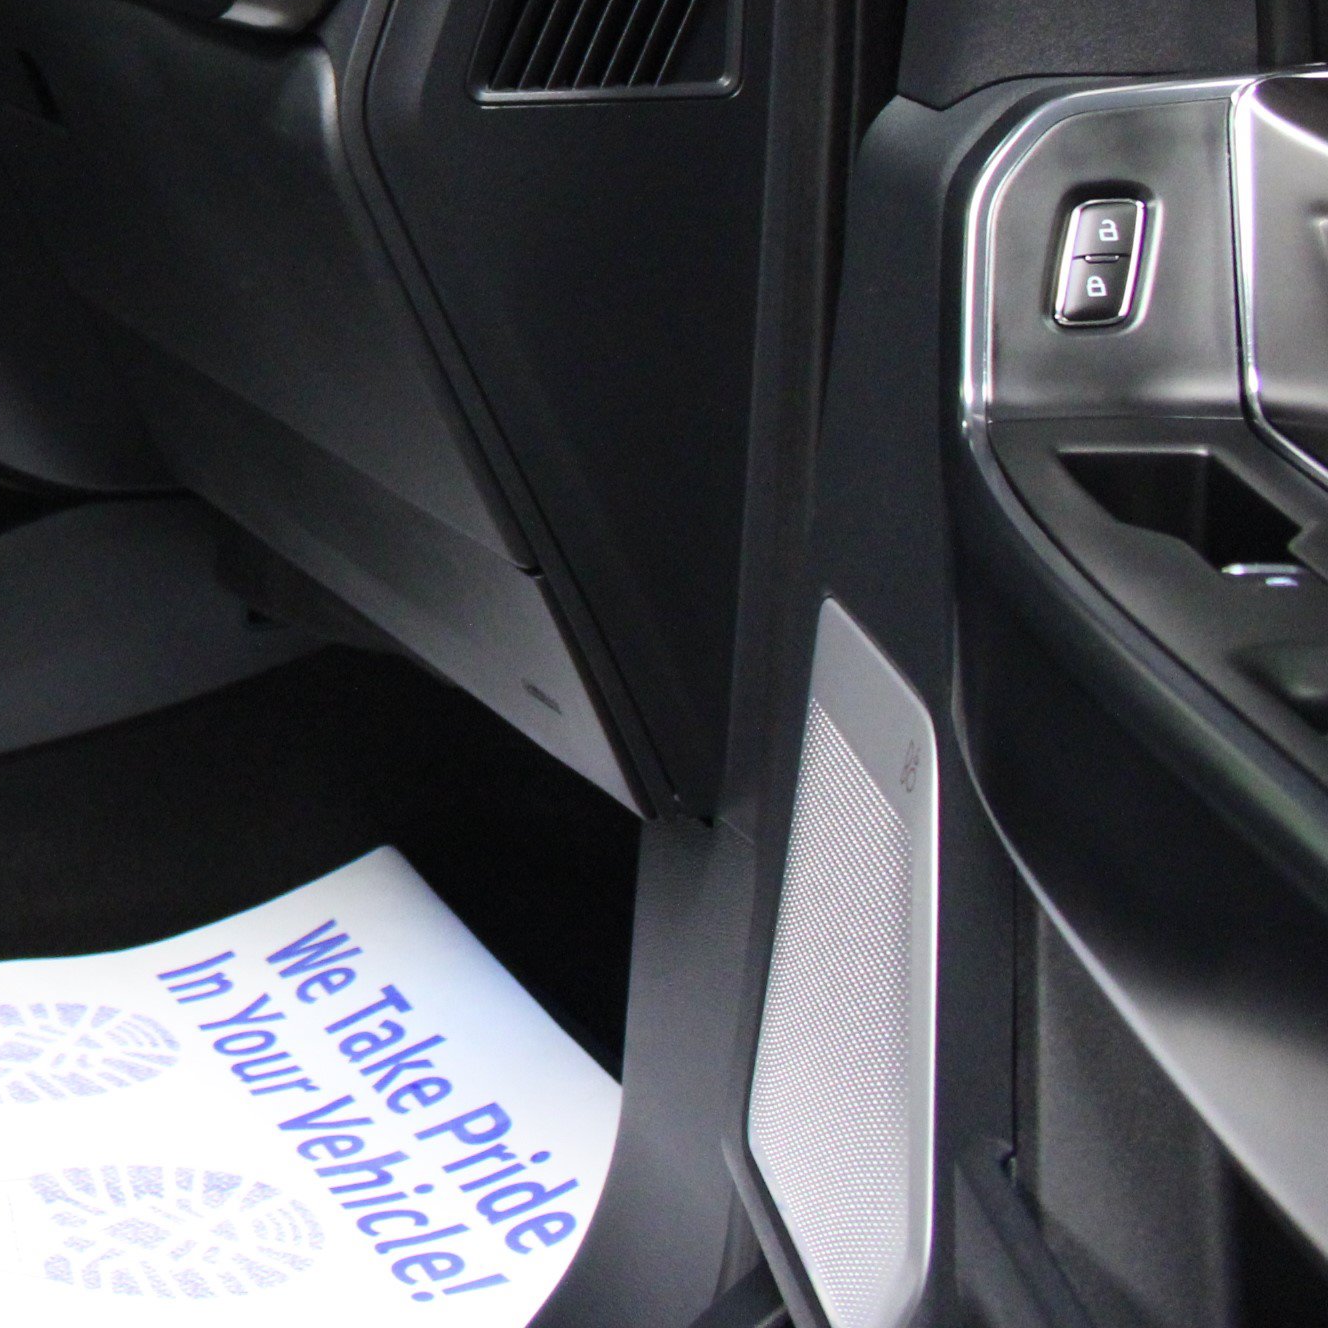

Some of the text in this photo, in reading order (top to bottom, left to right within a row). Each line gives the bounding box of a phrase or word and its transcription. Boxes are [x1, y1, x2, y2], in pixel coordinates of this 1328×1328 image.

[156, 950, 511, 1303] In Your Vehicle!
[265, 918, 579, 1255] We Take Pride
